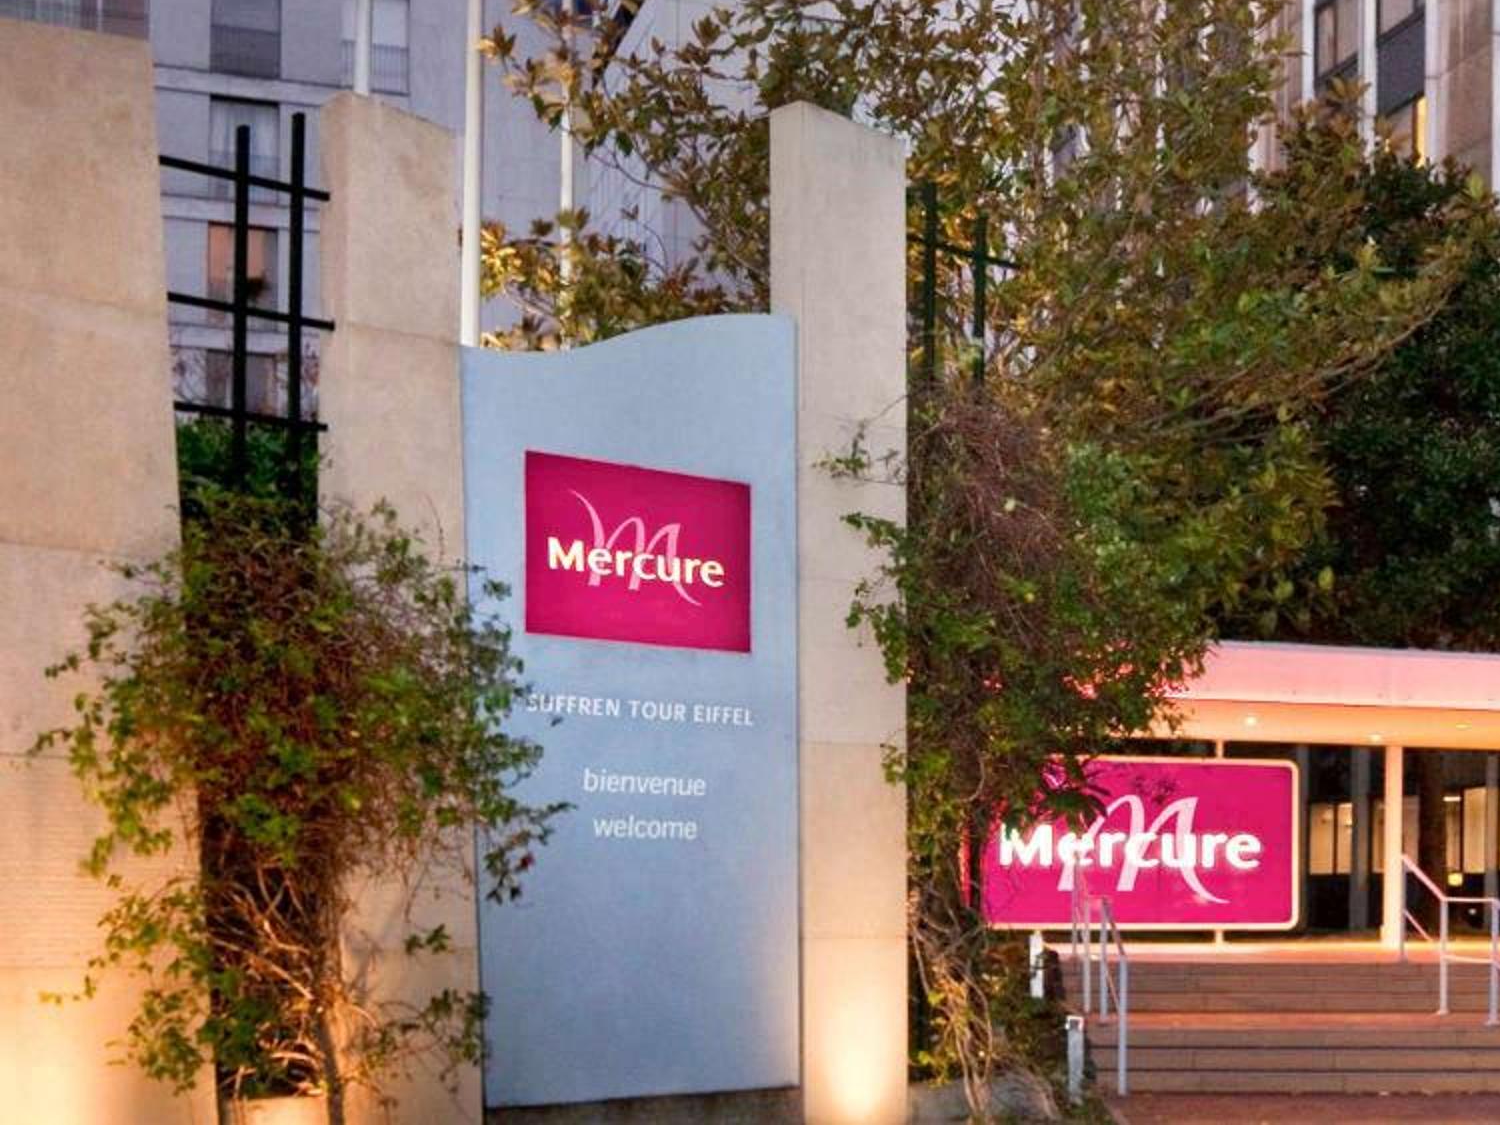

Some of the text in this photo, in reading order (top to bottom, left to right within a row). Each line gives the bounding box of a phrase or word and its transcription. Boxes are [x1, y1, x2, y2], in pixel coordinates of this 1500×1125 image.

[547, 536, 725, 588] Mercure
[526, 694, 753, 726] SUFFREN TOUR EIFFEL
[583, 768, 707, 796] bienvenue
[593, 815, 698, 841] welcome
[999, 822, 1263, 869] Mercure
